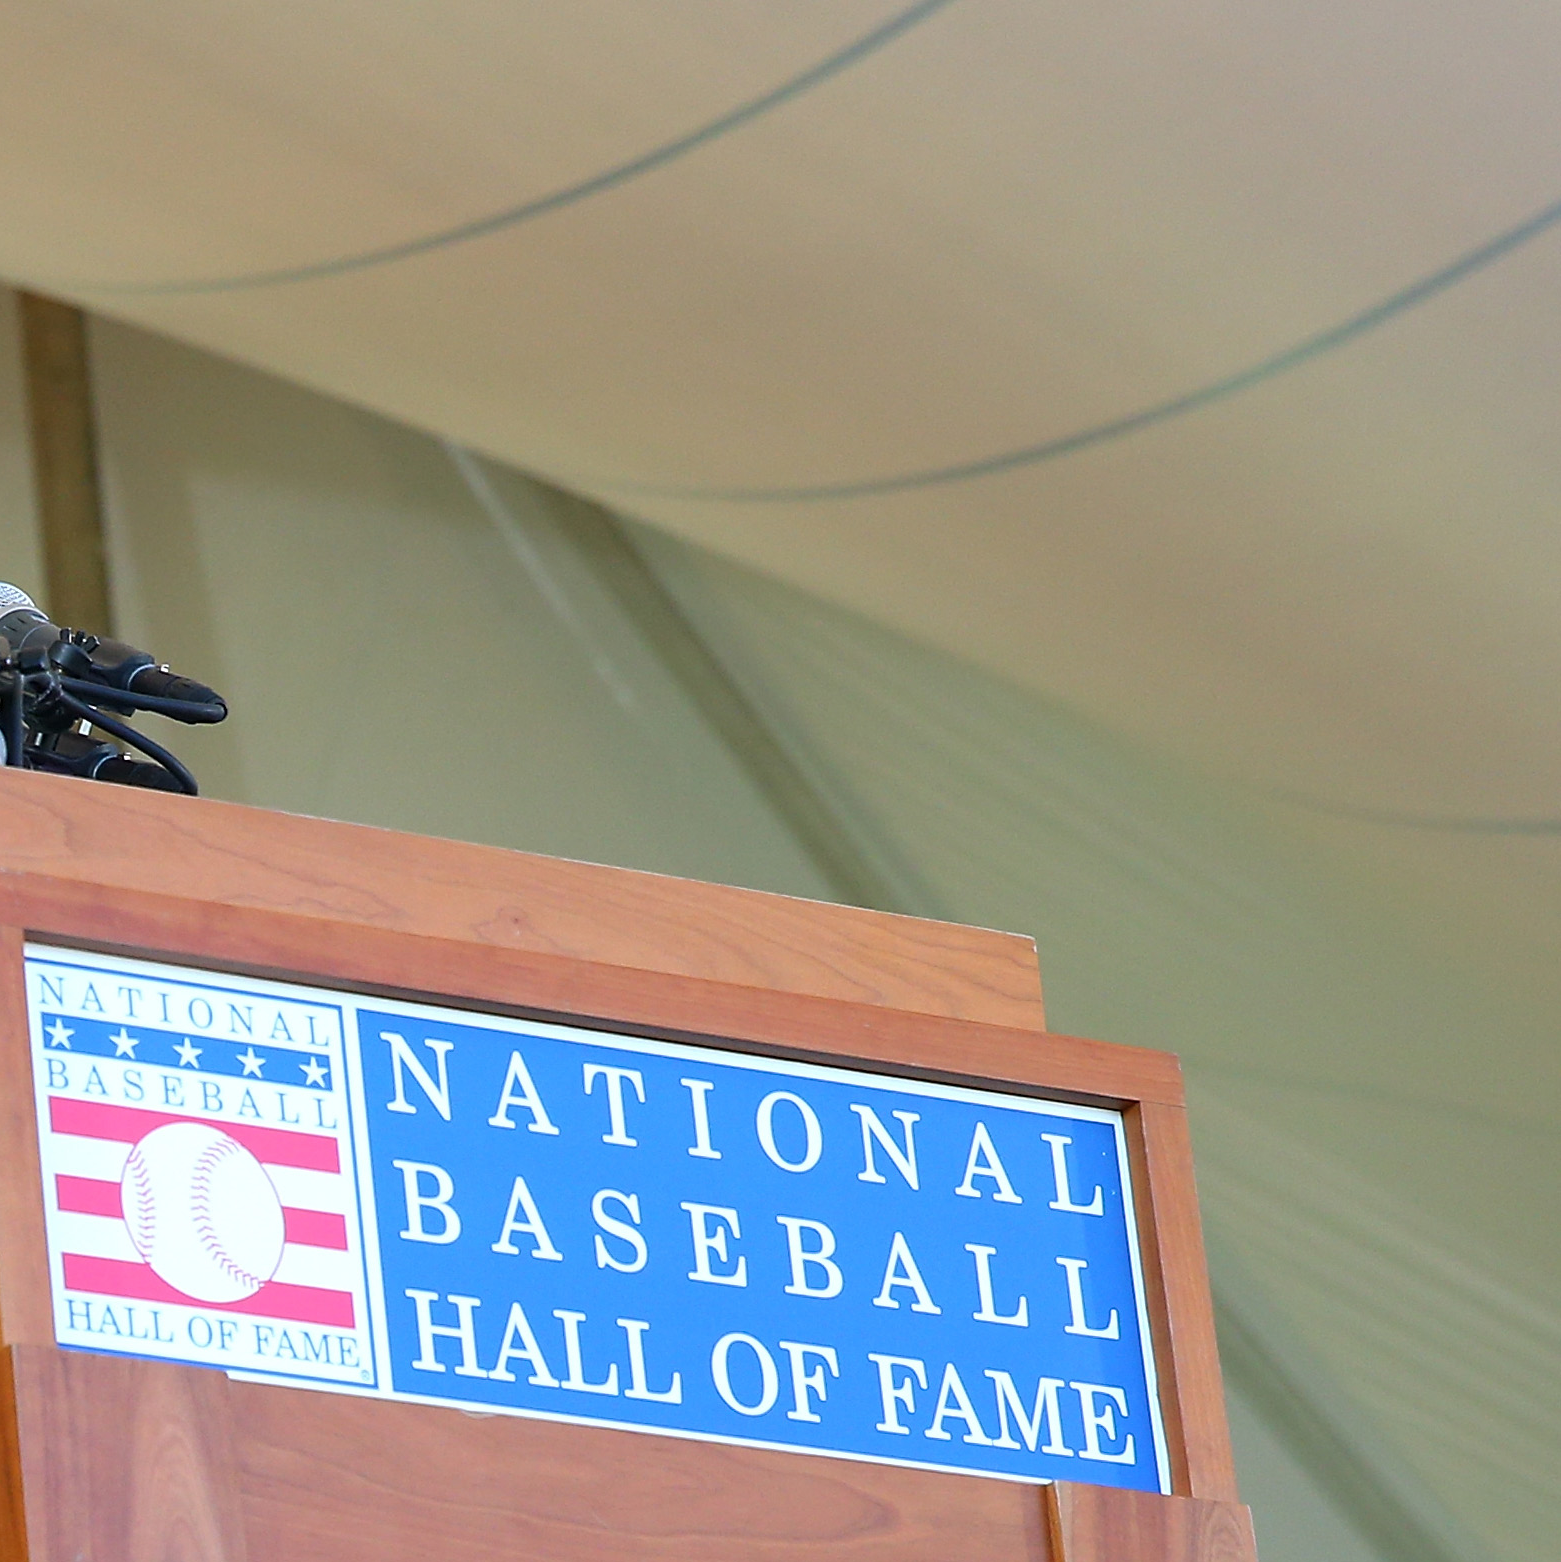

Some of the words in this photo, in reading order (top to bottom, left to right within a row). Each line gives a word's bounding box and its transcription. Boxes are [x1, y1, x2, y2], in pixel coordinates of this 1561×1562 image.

[36, 973, 330, 1047] NATIONAL
[42, 1057, 338, 1130] BASEBALL
[379, 1031, 1105, 1217] NATIONAL
[392, 1158, 1120, 1341] BASEBALL
[64, 1299, 175, 1344] HALL
[187, 1316, 238, 1350] OF
[254, 1324, 361, 1369] FAME
[404, 1287, 683, 1405] HALL
[710, 1330, 841, 1424] OF
[867, 1352, 1137, 1467] FAME
